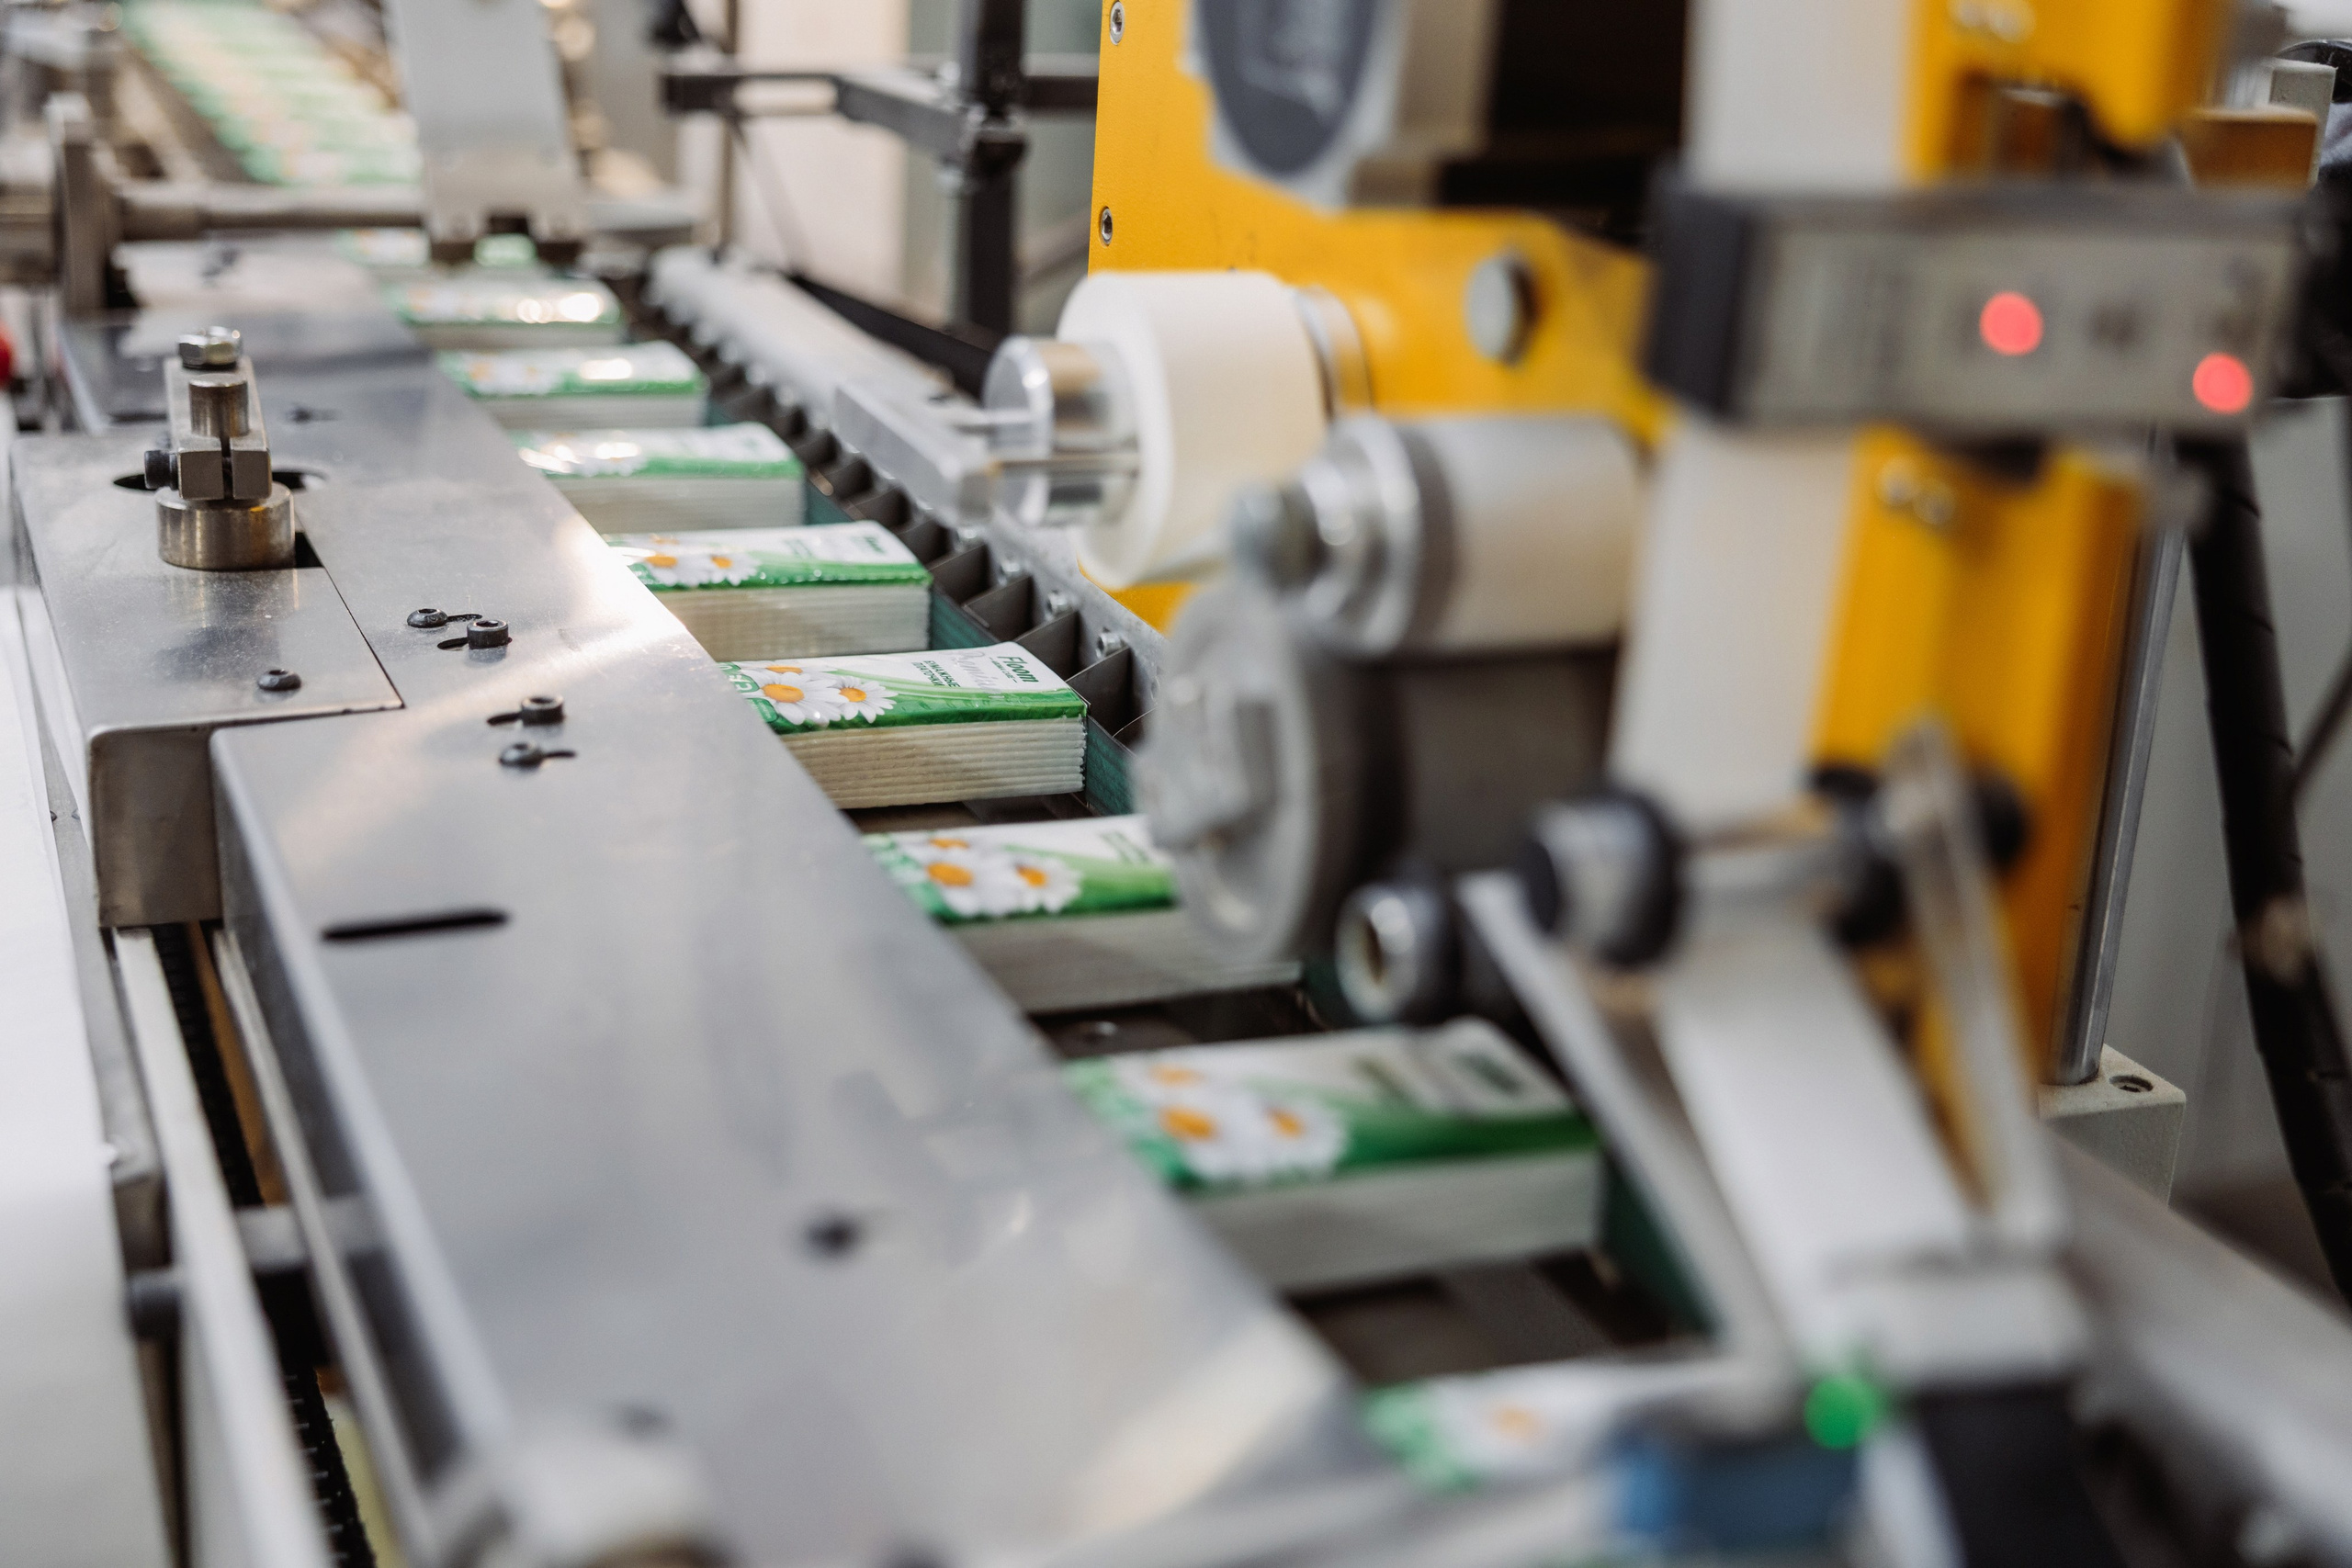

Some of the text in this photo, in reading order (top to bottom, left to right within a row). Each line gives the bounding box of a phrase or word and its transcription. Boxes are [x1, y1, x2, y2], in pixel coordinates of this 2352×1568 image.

[910, 662, 945, 686] ПЛАТОЧКИ
[922, 660, 961, 687] БУМАЖНЫЕ
[996, 656, 1040, 682] Floom
